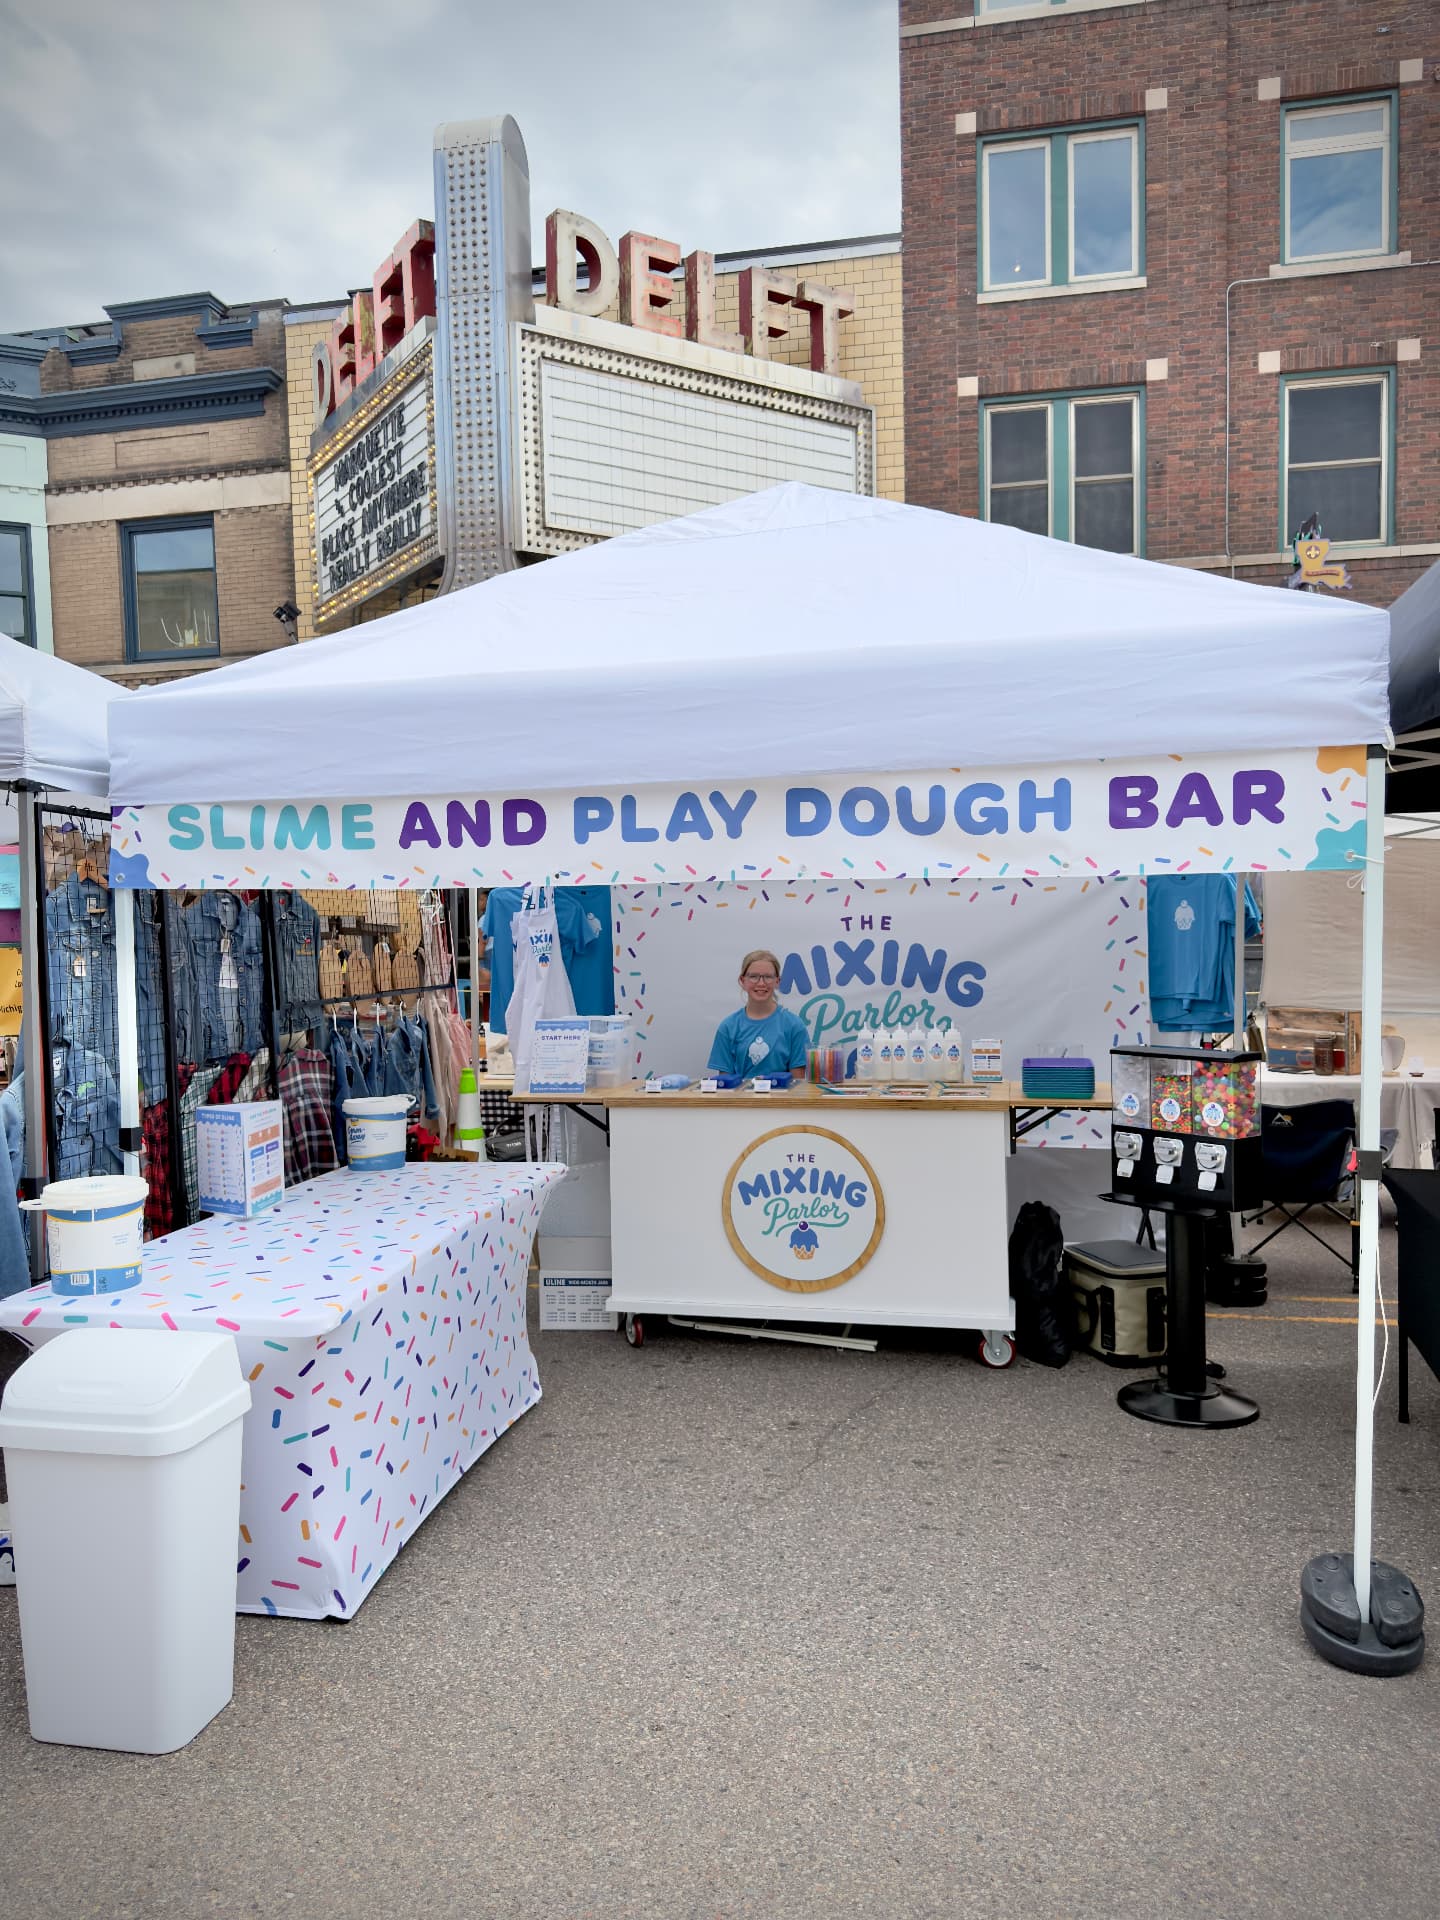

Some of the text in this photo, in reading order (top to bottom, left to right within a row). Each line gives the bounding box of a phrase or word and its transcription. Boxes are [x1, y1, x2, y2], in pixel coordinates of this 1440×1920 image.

[313, 219, 435, 430] DELFT
[546, 208, 854, 375] DELFT
[334, 401, 406, 492] MARQUETTE
[349, 441, 403, 512] COOLEST
[322, 461, 428, 567] PLACE ANYWHERE
[329, 502, 422, 594] REALLY REALLY
[168, 769, 1286, 851] SLIME AND PLAY DOUGH BAR
[840, 914, 892, 932] THE
[799, 990, 953, 1045] Parlor
[737, 1166, 868, 1208] MIXING
[786, 1153, 816, 1163] THE
[762, 1196, 850, 1237] Parlor
